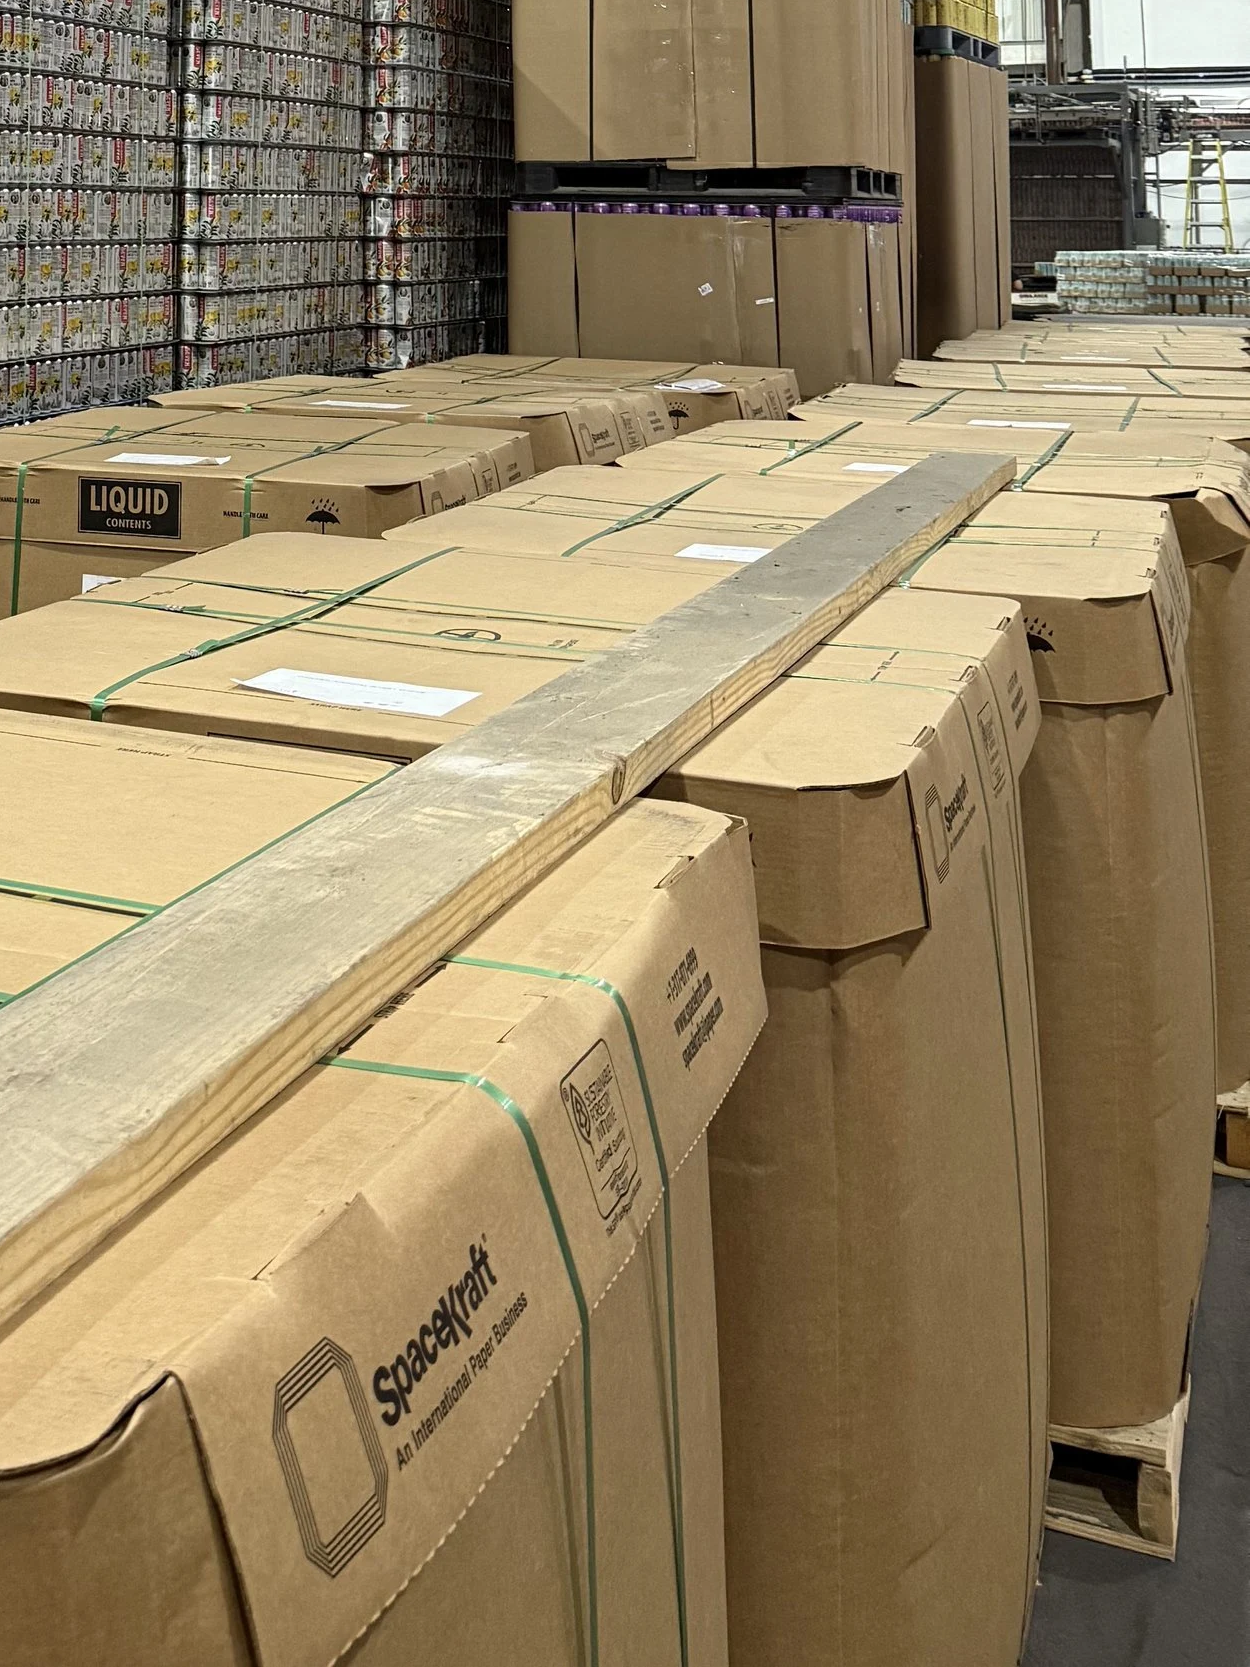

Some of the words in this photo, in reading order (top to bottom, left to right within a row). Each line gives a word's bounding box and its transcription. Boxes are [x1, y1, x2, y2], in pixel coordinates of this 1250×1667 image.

[90, 485, 169, 515] LIQUID
[106, 517, 151, 529] CONTENTS
[373, 1243, 497, 1426] SpaceKraft
[396, 1443, 414, 1472] An
[413, 1364, 472, 1451] International
[469, 1336, 494, 1378] Paper
[493, 1291, 528, 1346] Business
